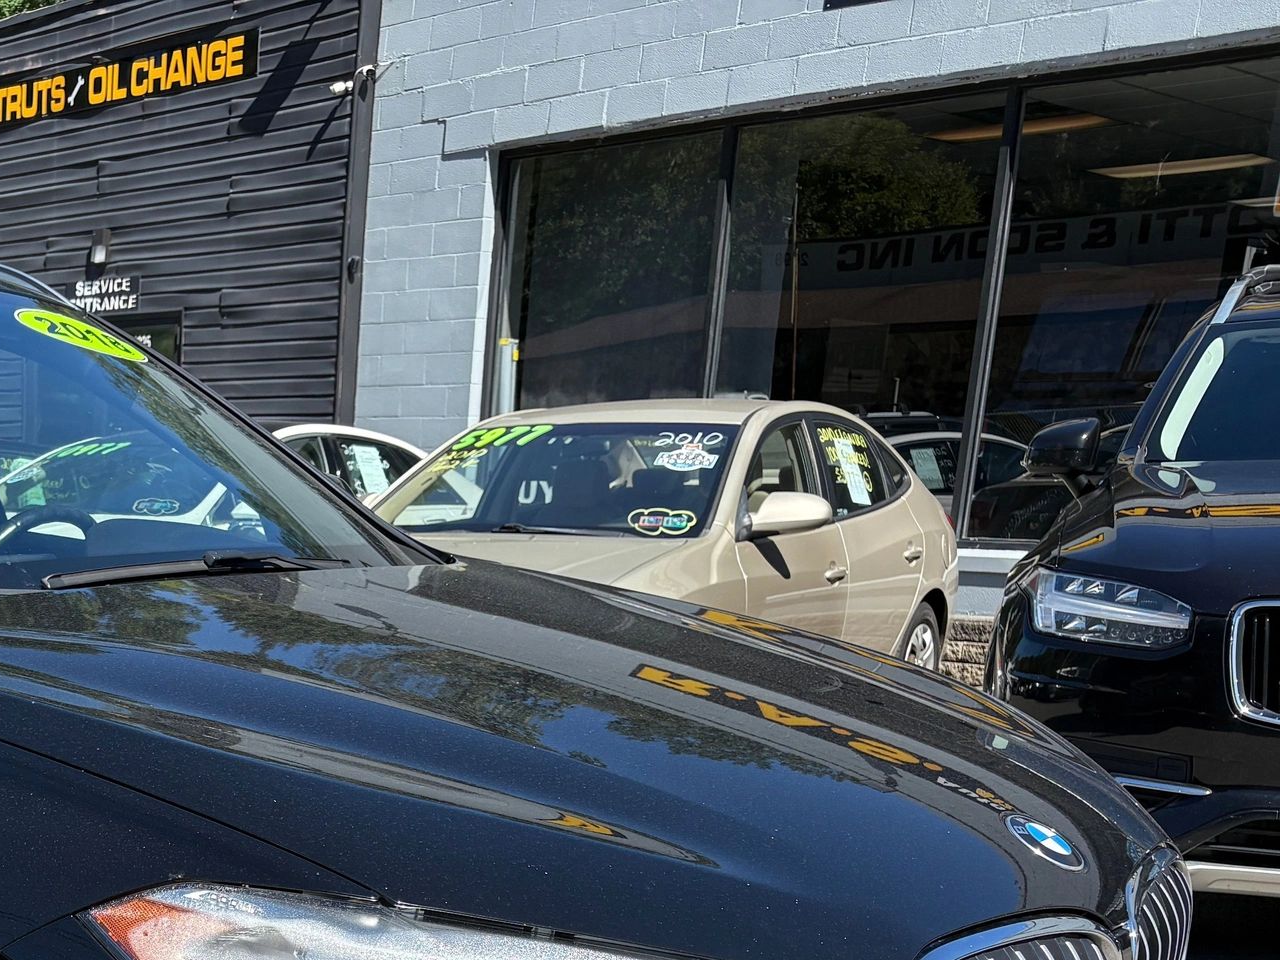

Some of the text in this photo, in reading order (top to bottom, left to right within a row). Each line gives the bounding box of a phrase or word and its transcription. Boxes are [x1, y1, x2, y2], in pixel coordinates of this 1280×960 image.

[88, 65, 128, 106] OIL
[130, 35, 246, 97] CHANGE
[75, 278, 131, 297] SERVICE
[70, 294, 137, 313] NTRANCE
[655, 431, 724, 446] 2010
